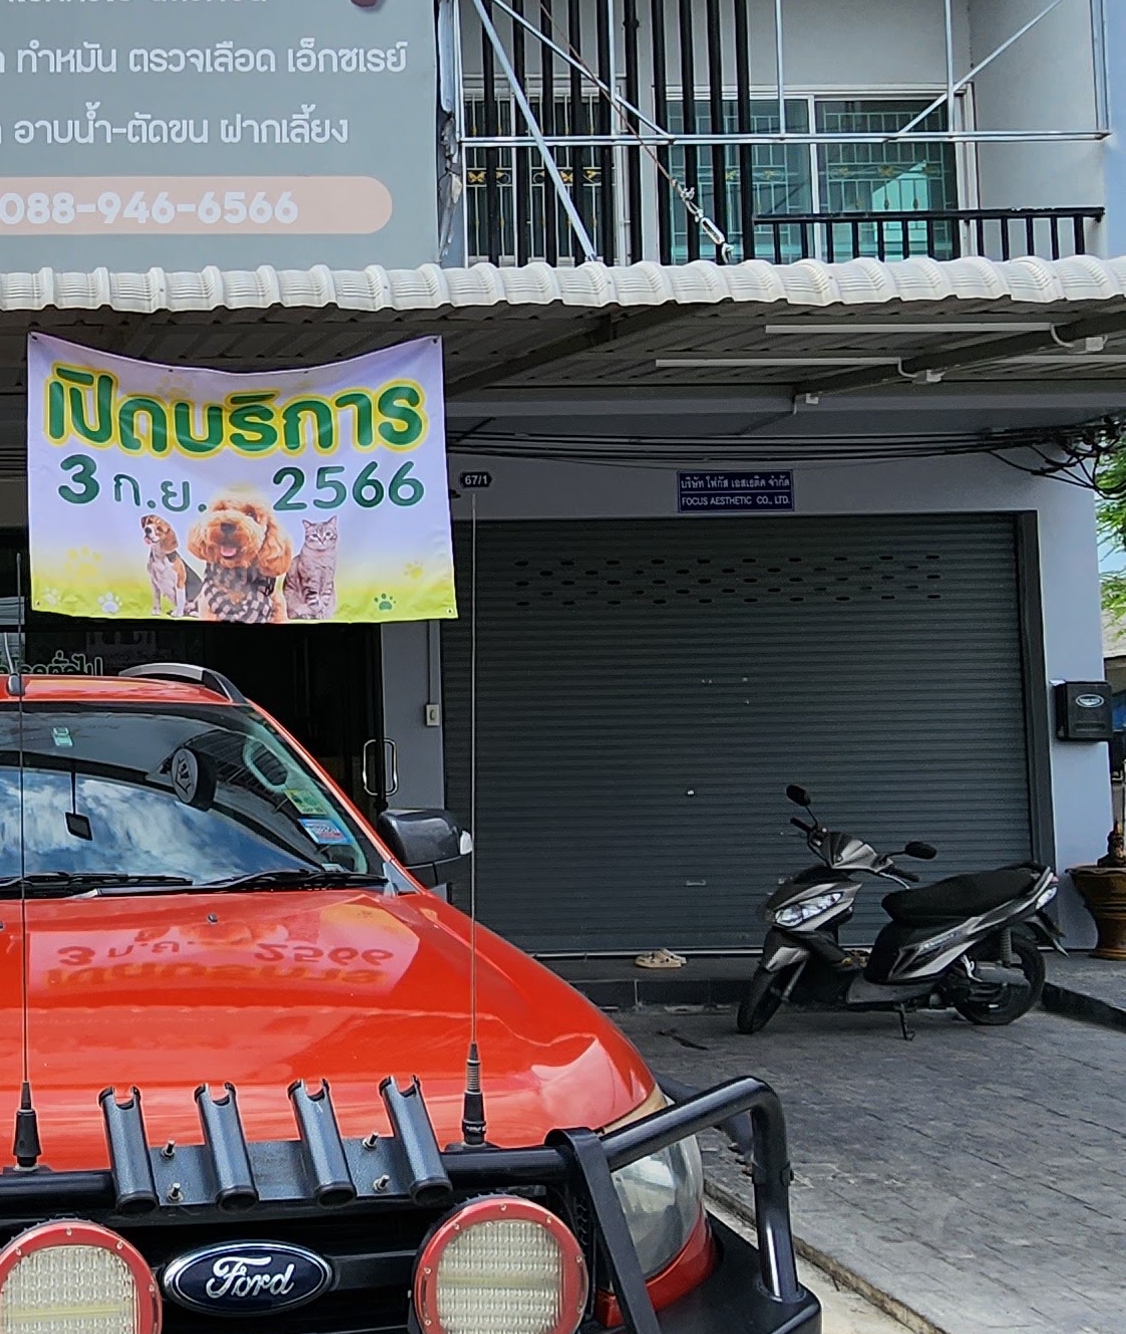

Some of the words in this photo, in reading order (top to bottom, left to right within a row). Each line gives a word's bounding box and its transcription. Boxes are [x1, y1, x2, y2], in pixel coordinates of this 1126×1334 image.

[18, 40, 116, 72] ทำหมัน
[130, 41, 275, 72] ตรวจเลือด
[288, 38, 408, 72] เอ็กซเรย์
[15, 102, 208, 143] อาบน้ำ-ตัดขน
[221, 104, 347, 143] ฝากเลี้ยง
[45, 364, 427, 455] เปิดบริการ
[59, 454, 99, 504] 3
[114, 474, 207, 512] ก.ย.
[273, 461, 424, 510] 2566
[464, 473, 490, 486] 67/1
[681, 496, 709, 507] FOCUS
[710, 496, 752, 506] AESTHETIC
[774, 495, 791, 505] LTD.
[204, 1256, 297, 1300] Ford
